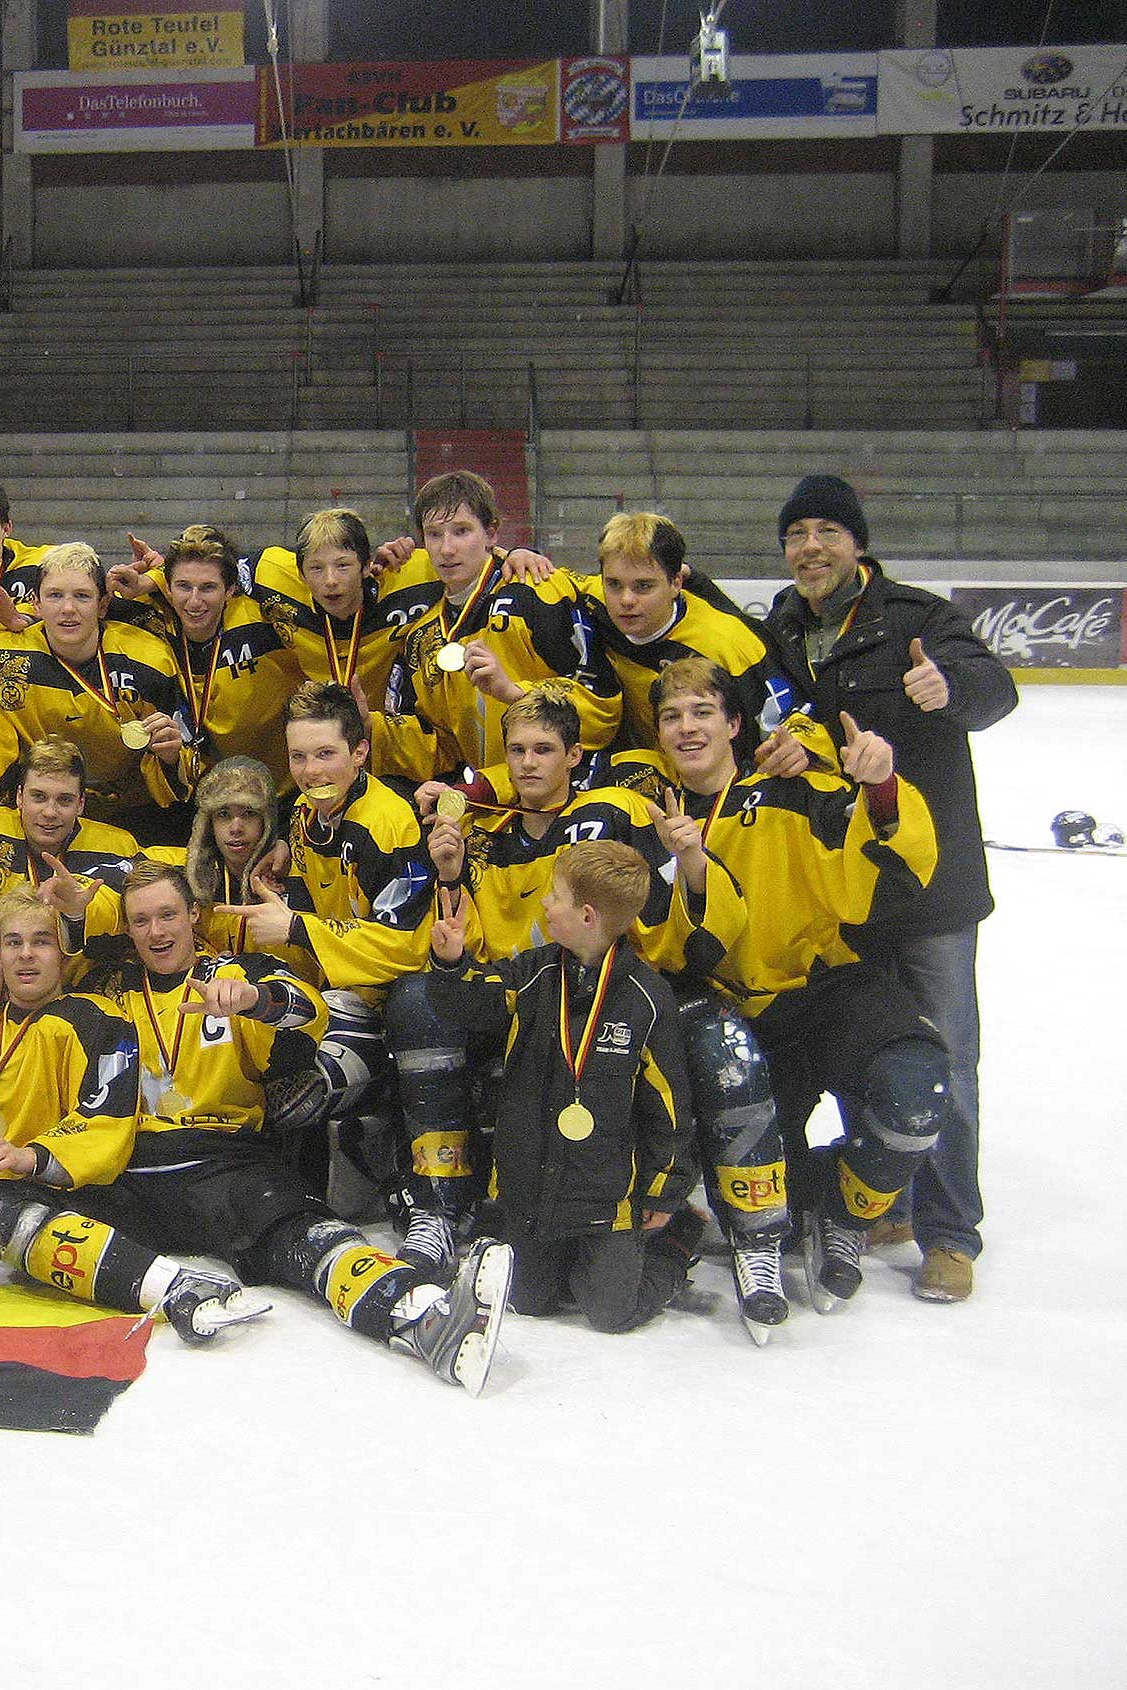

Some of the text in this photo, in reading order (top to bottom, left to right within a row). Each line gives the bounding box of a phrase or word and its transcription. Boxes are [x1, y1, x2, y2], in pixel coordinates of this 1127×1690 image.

[91, 16, 219, 36] Rote Teufel
[91, 38, 176, 57] Günztal
[294, 91, 457, 117] Fan-Club
[1004, 87, 1091, 101] SUBARU
[959, 103, 1066, 127] Schmitz
[221, 643, 259, 680] 14
[109, 670, 140, 704] 15
[740, 791, 763, 828] 8
[564, 820, 604, 846] 17
[729, 1169, 780, 1208] ept
[51, 1230, 89, 1291] ept
